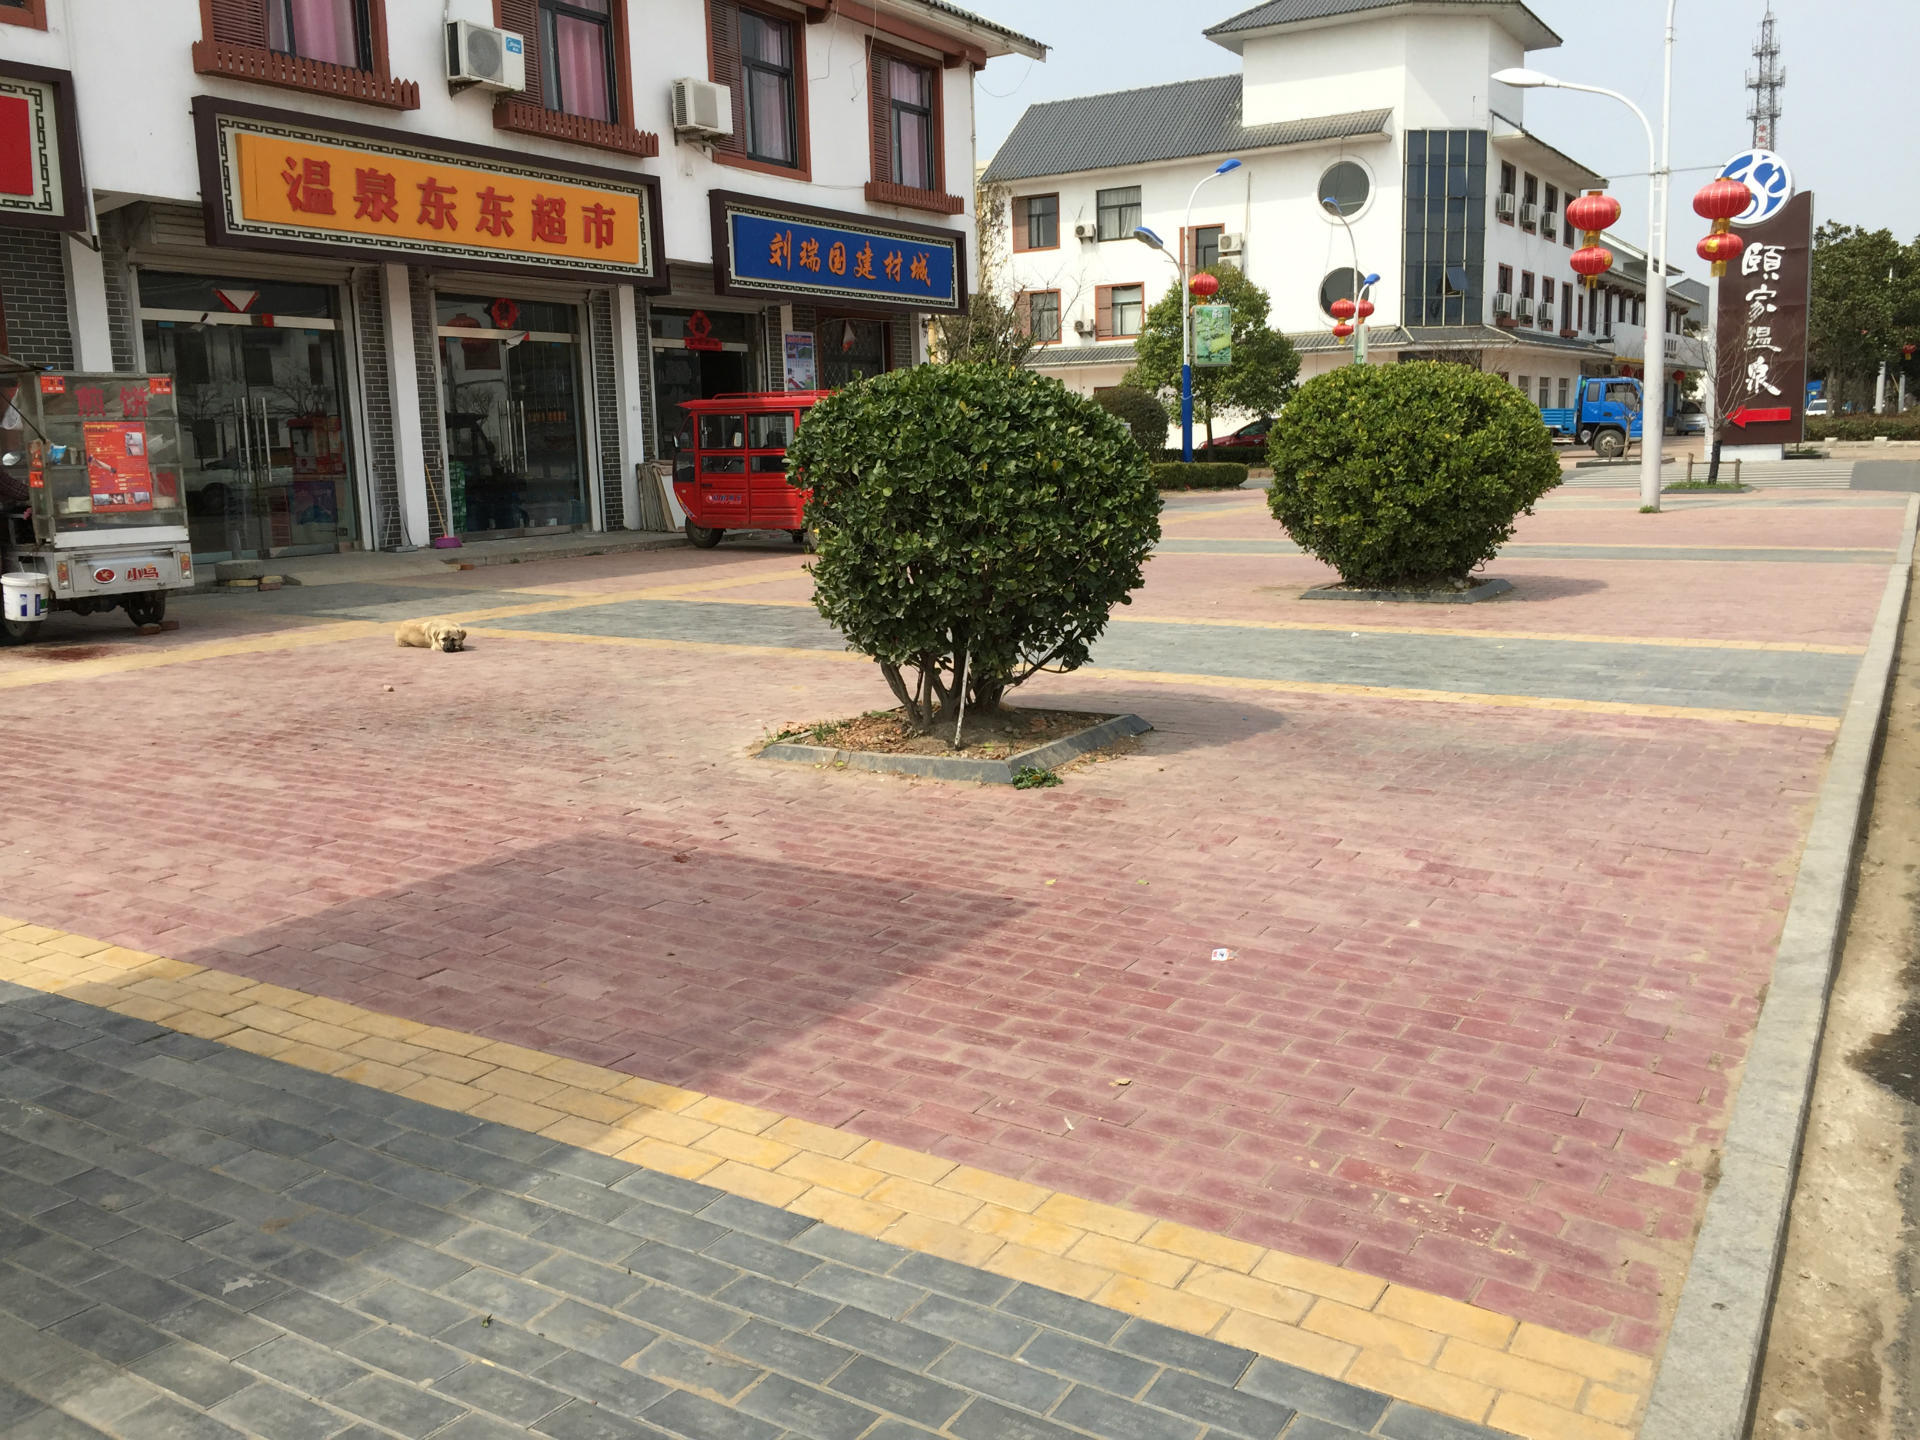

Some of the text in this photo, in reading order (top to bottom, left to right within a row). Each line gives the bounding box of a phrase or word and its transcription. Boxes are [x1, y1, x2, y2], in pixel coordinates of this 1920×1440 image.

[281, 156, 617, 249] 温泉东东超市
[74, 386, 149, 417] 煎饼
